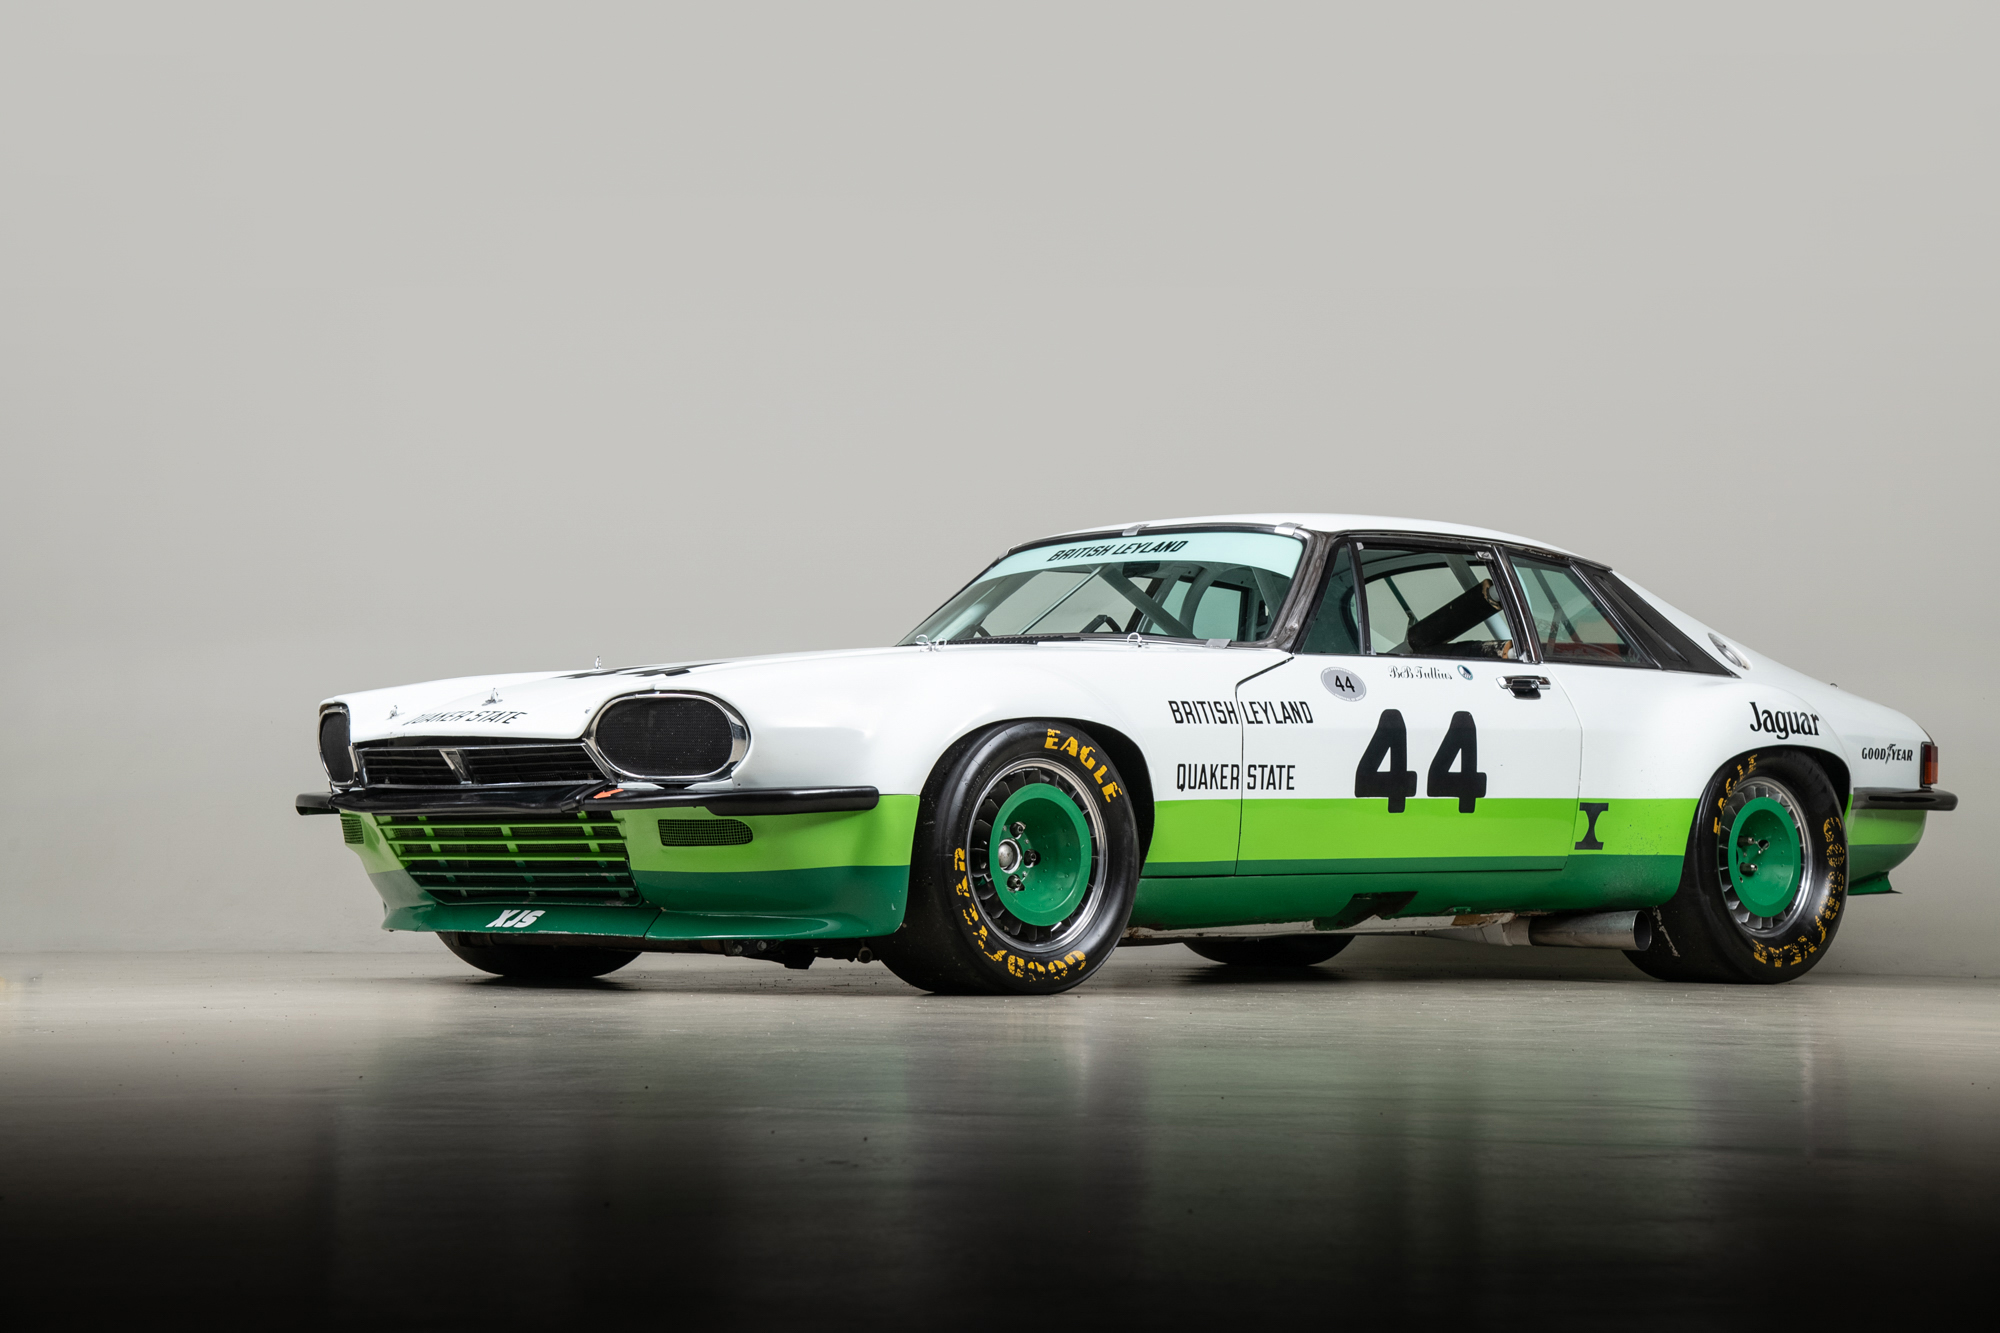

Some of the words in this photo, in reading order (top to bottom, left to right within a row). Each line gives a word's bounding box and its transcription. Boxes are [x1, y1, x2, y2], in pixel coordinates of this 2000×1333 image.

[1046, 544, 1115, 562] BRITISH
[1111, 540, 1190, 555] LEYLAND
[1335, 674, 1356, 692] 44
[465, 711, 528, 724] STATE
[1168, 700, 1239, 724] BRITISH
[1240, 701, 1314, 724] LEYLAND
[1749, 701, 1820, 740] Jaguar
[1044, 728, 1123, 803] EAGLE
[1354, 708, 1488, 814] 44
[1861, 743, 1914, 765] GOODYEAR
[1176, 763, 1240, 792] QUAKER
[1246, 764, 1296, 790] STATE
[485, 909, 546, 928] XJS
